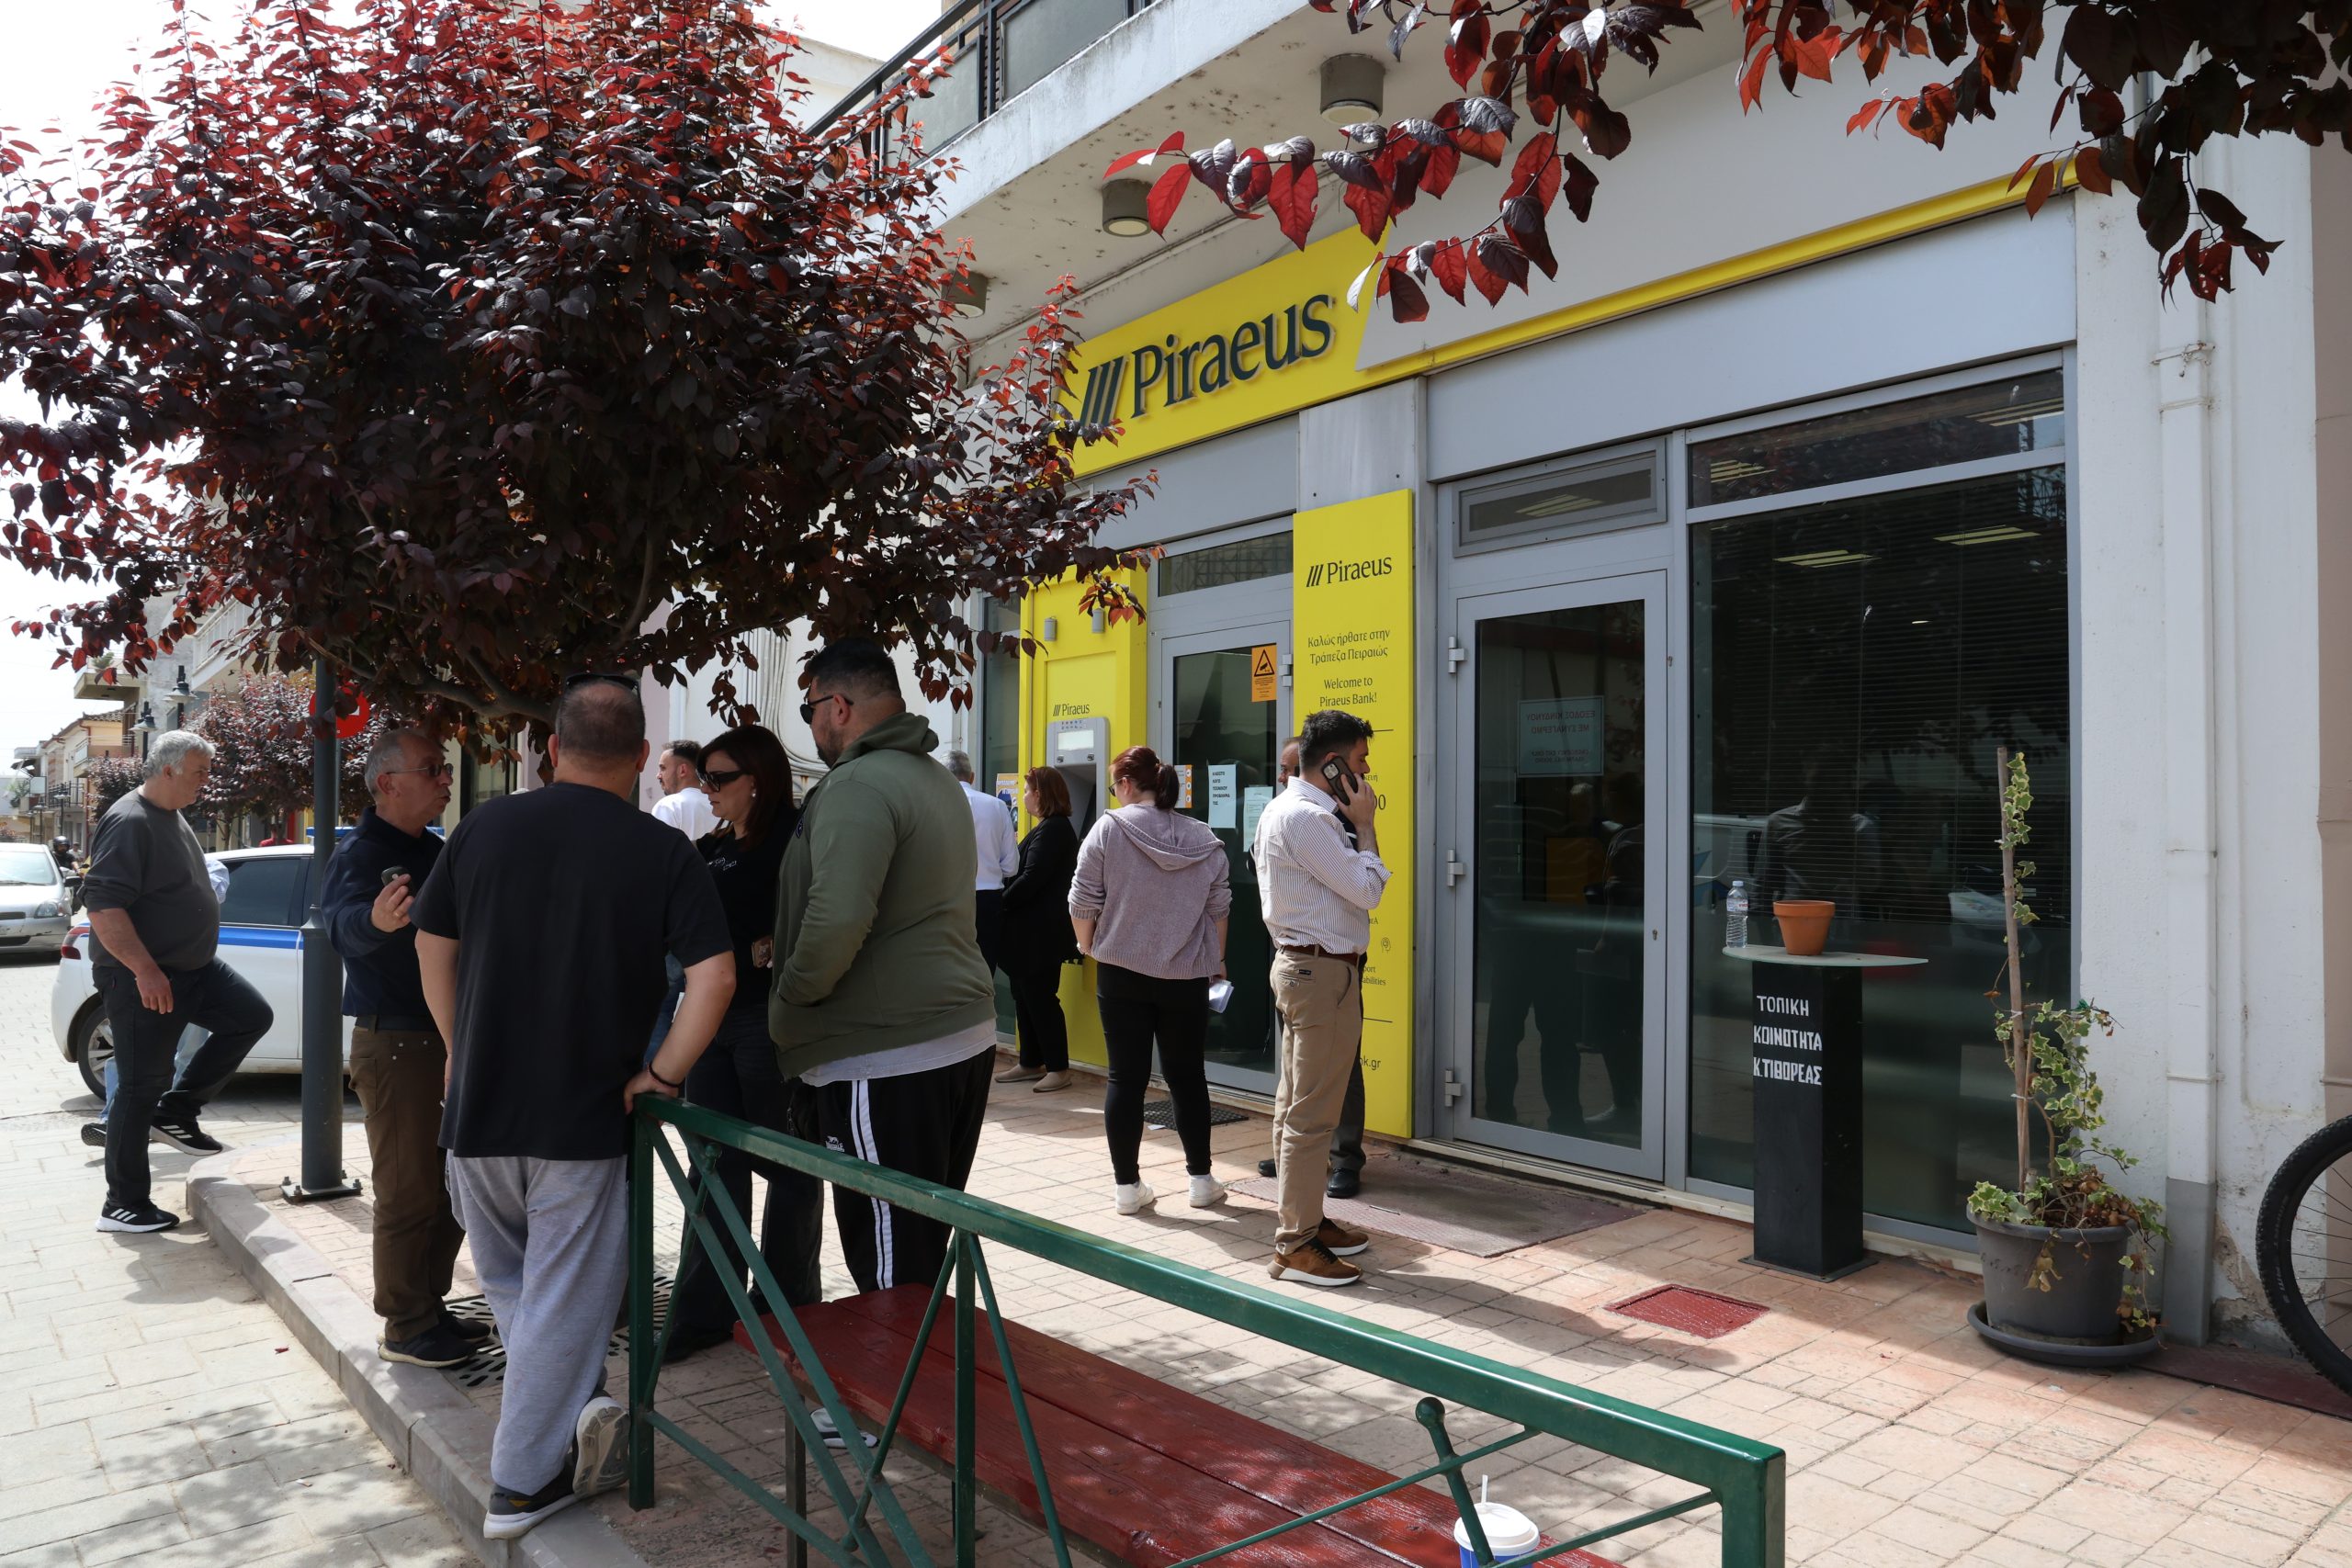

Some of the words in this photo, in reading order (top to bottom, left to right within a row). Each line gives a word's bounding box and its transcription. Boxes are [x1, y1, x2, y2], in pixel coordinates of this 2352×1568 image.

[1131, 294, 1334, 418] Piraeus
[1327, 557, 1392, 583] Piraeus
[1307, 634, 1336, 648] Καλώς
[1337, 631, 1367, 646] ήρθατε
[1369, 629, 1390, 641] στην
[1310, 649, 1346, 666] Τράπεζα
[1348, 646, 1388, 660] Πειραιώς
[1324, 678, 1362, 689] Welcome
[1363, 677, 1373, 686] to
[1319, 696, 1351, 706] Piraeus
[1352, 692, 1377, 705] Bank!
[1062, 703, 1091, 716] Piraeus
[1756, 995, 1810, 1017] ΤΟΠΙΚΗ
[1753, 1024, 1823, 1052] ΚΟΙΝΟΤΗΤΑ
